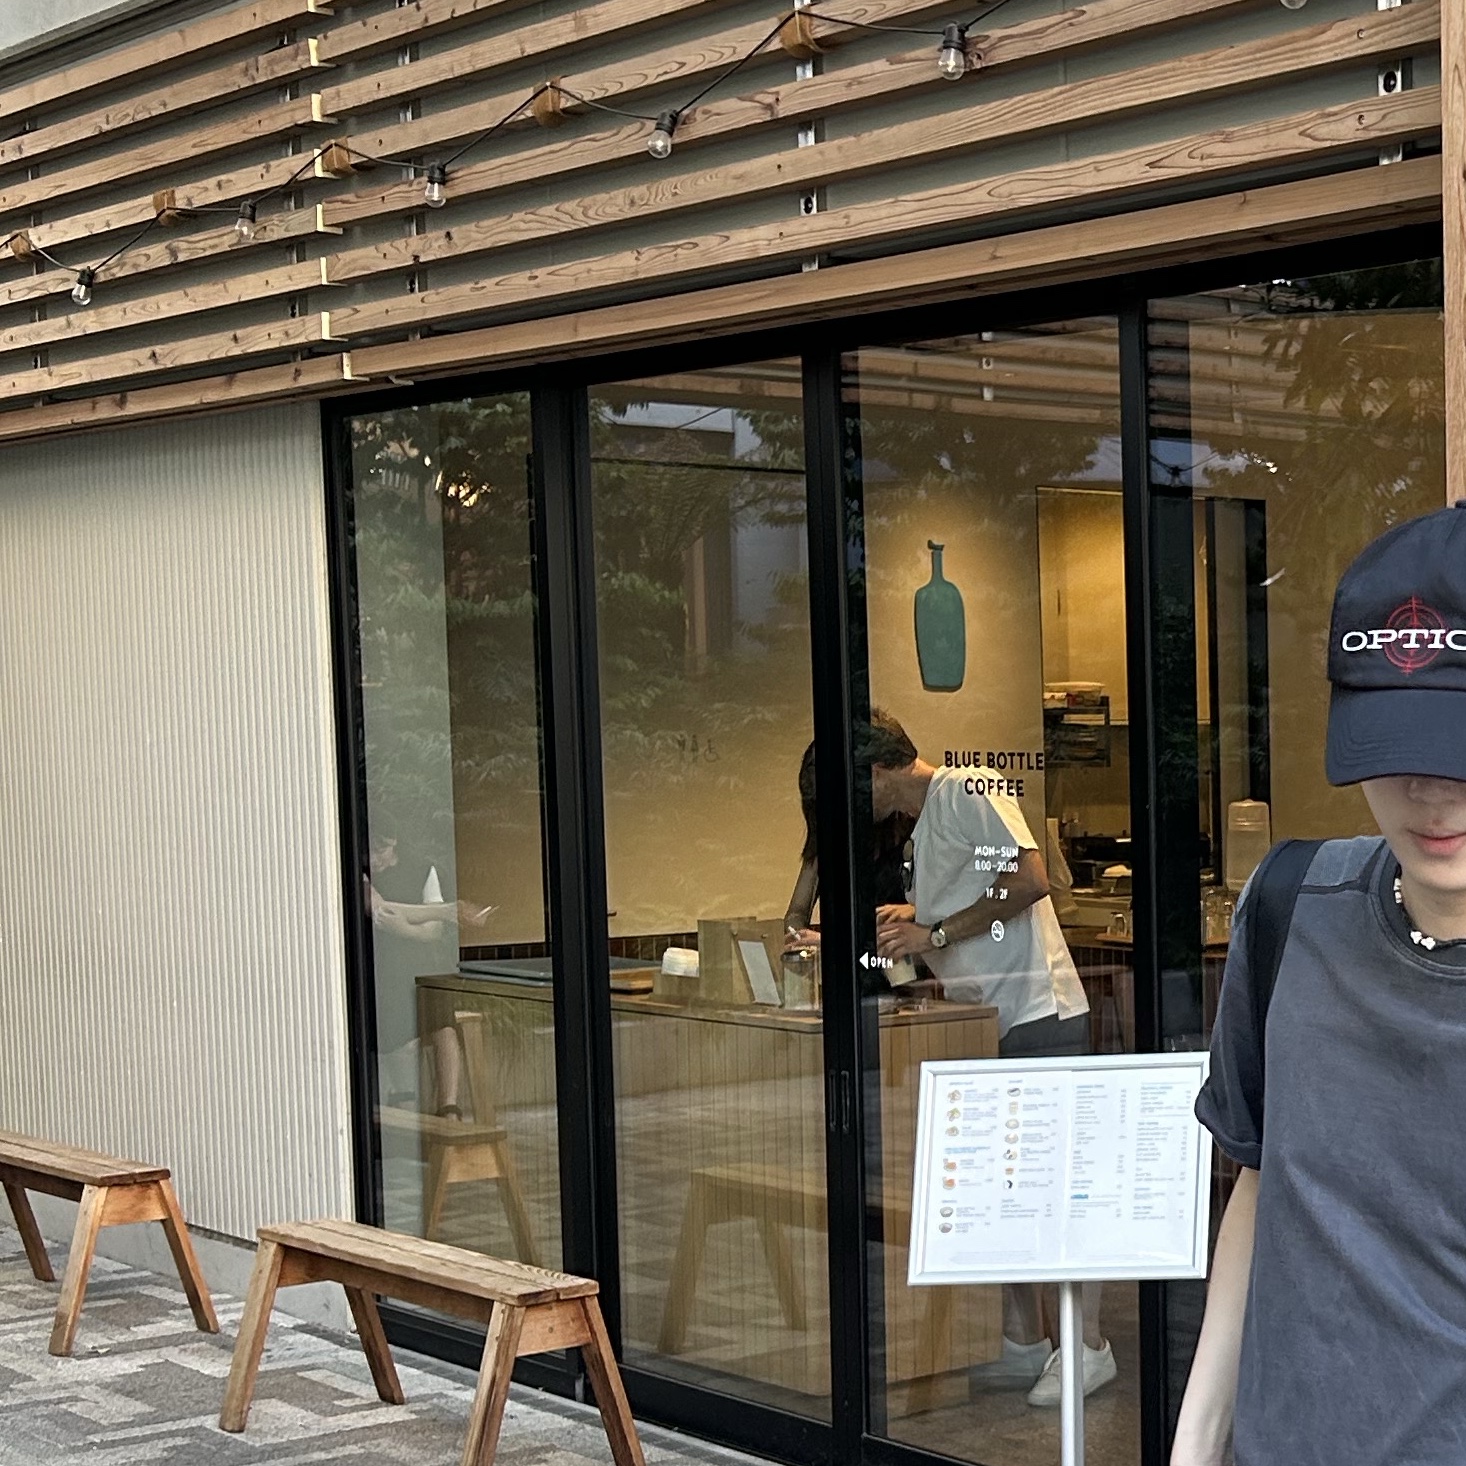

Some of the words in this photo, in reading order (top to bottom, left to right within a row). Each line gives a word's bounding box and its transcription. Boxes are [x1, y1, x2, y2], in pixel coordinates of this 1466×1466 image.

[944, 750, 981, 769] BLUE
[986, 752, 1045, 770] BOTTLE
[964, 777, 1025, 797] COFFEE
[974, 845, 1019, 858] MON-SUN
[870, 955, 894, 969] OPEN
